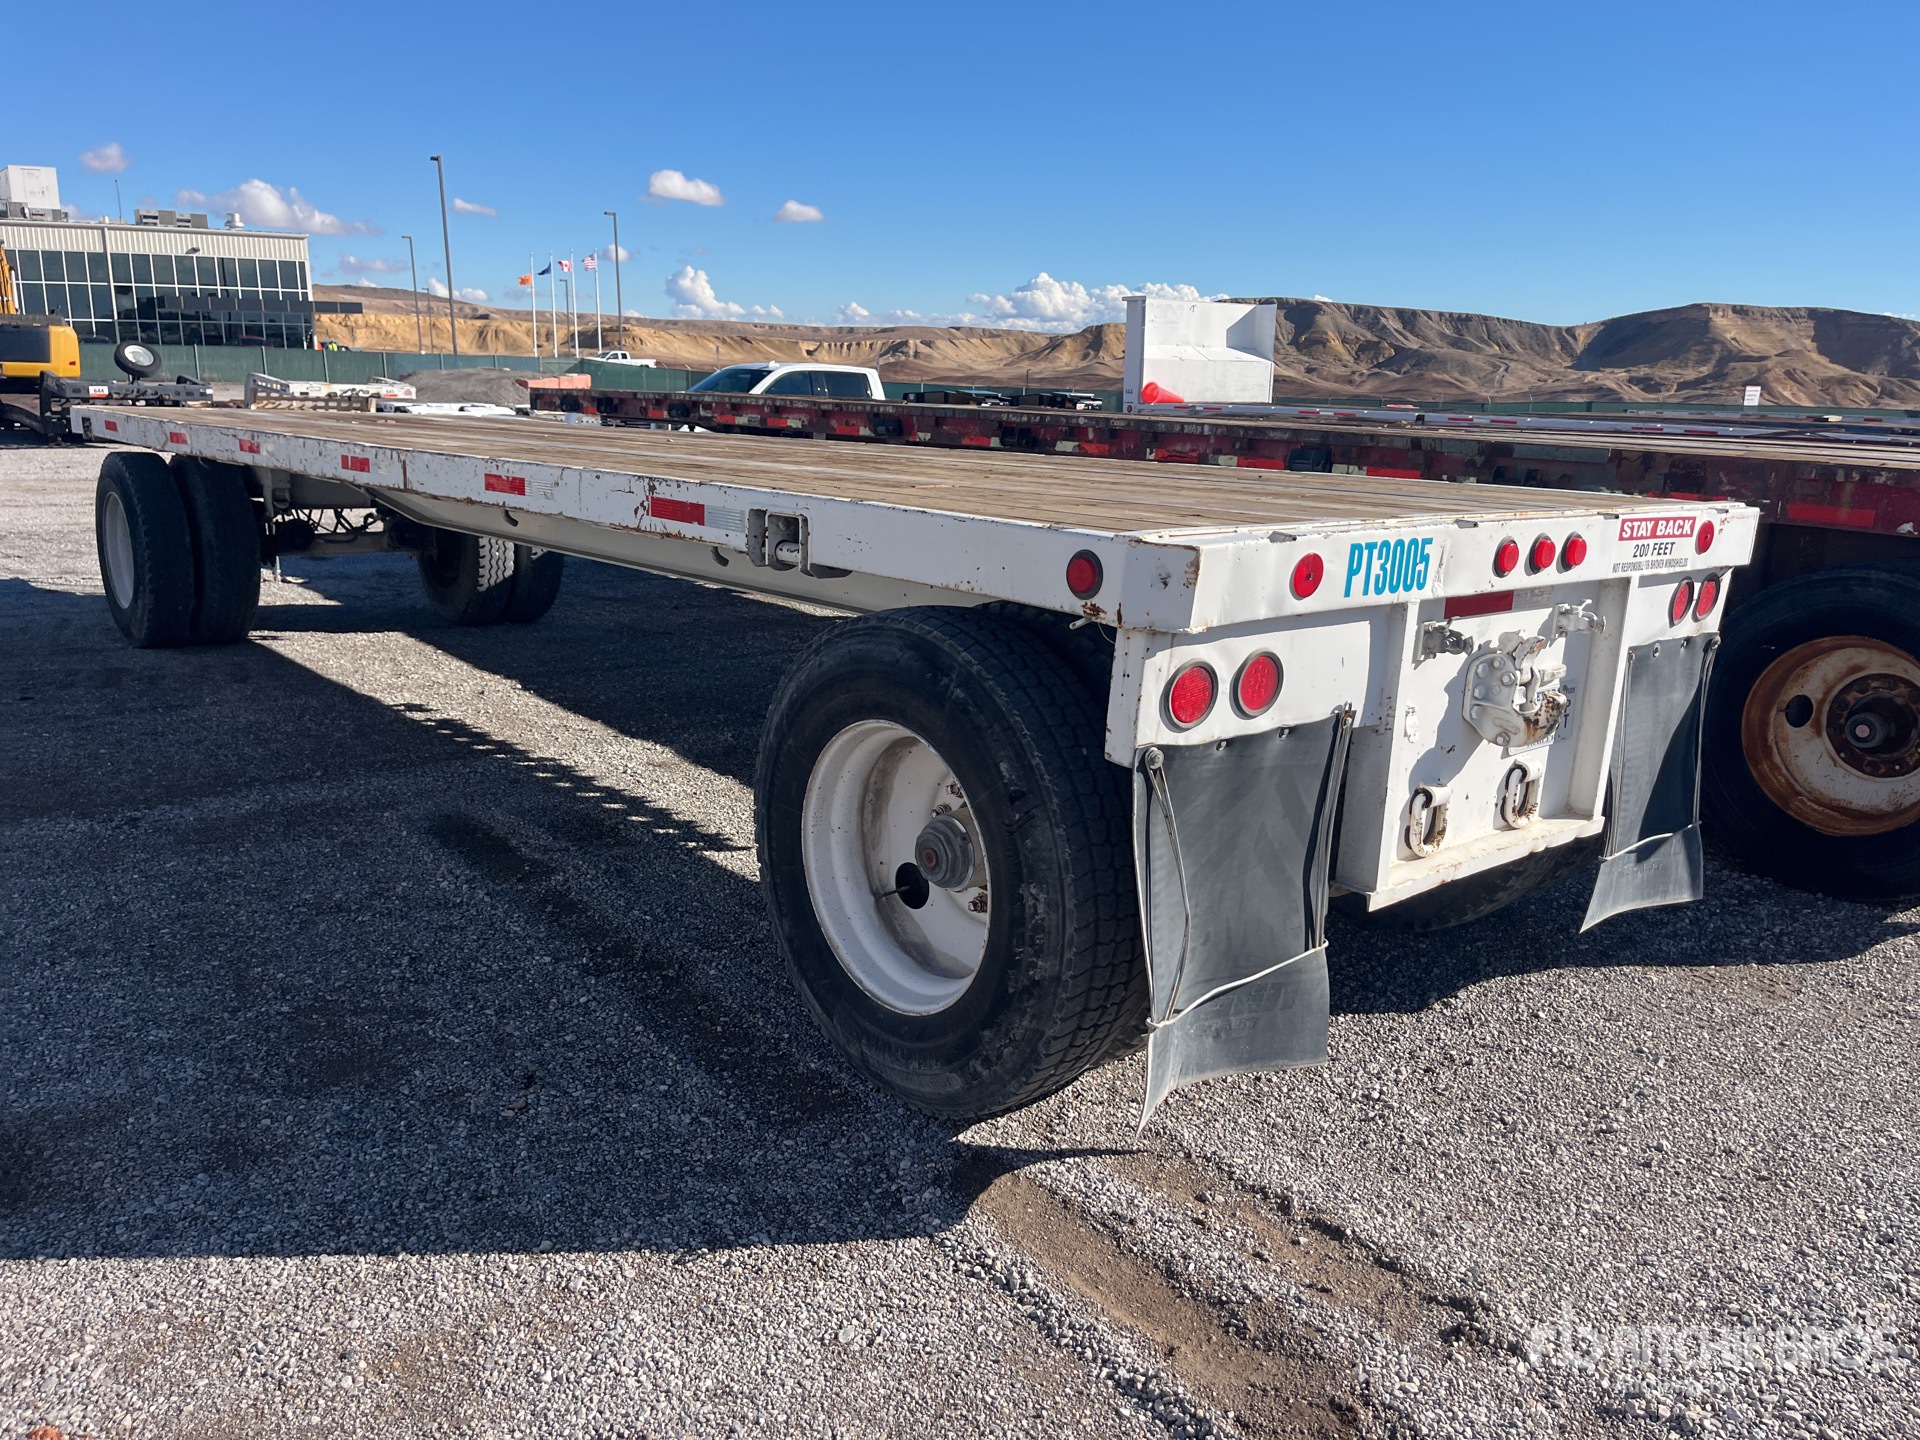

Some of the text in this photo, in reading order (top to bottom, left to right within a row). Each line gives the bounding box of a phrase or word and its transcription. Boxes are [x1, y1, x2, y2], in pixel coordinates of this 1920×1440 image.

[1622, 519, 1694, 538] STAY BACK
[1633, 541, 1676, 558] 200 FEET
[1343, 537, 1434, 598] PT3005
